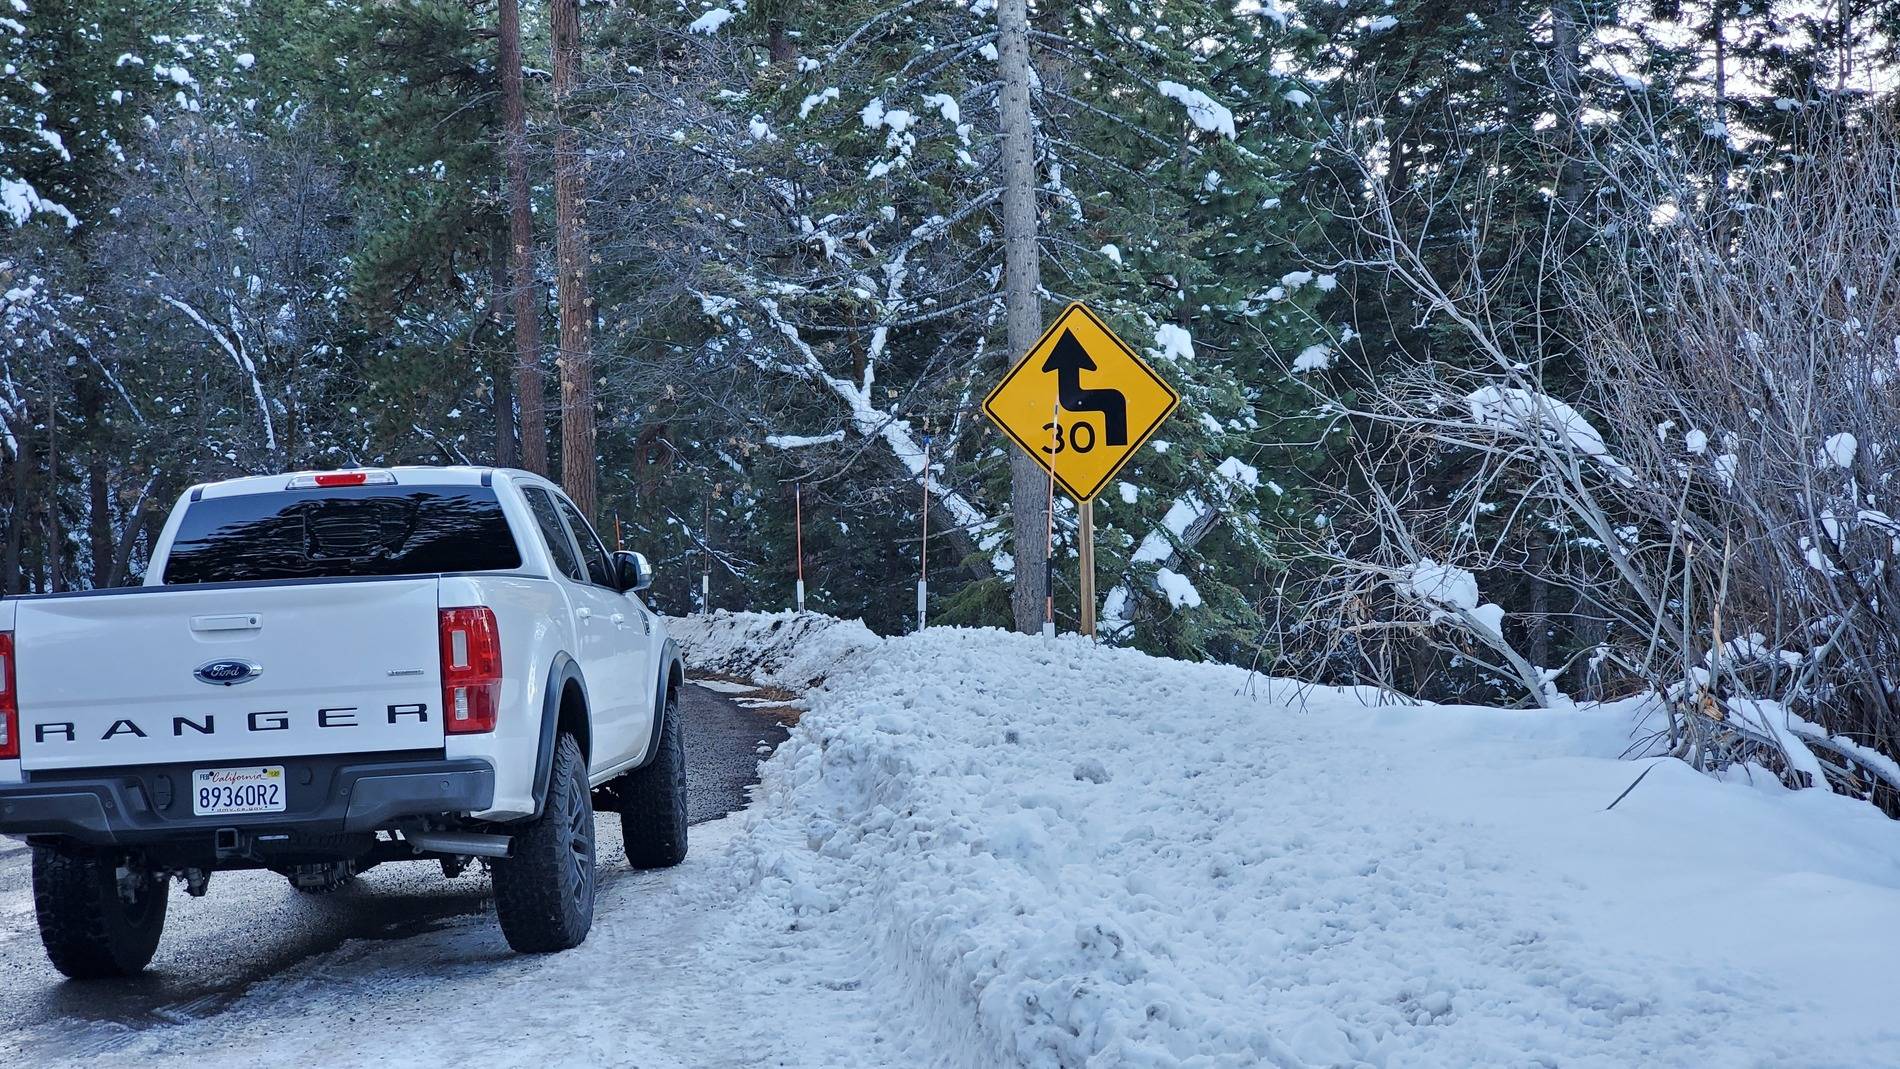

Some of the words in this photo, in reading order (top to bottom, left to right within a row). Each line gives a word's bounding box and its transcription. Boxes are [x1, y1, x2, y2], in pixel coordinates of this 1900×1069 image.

[1042, 421, 1096, 454] 30
[211, 664, 240, 676] Ford
[35, 703, 428, 743] RANGER
[212, 771, 264, 784] California
[200, 784, 280, 809] 89360R2
